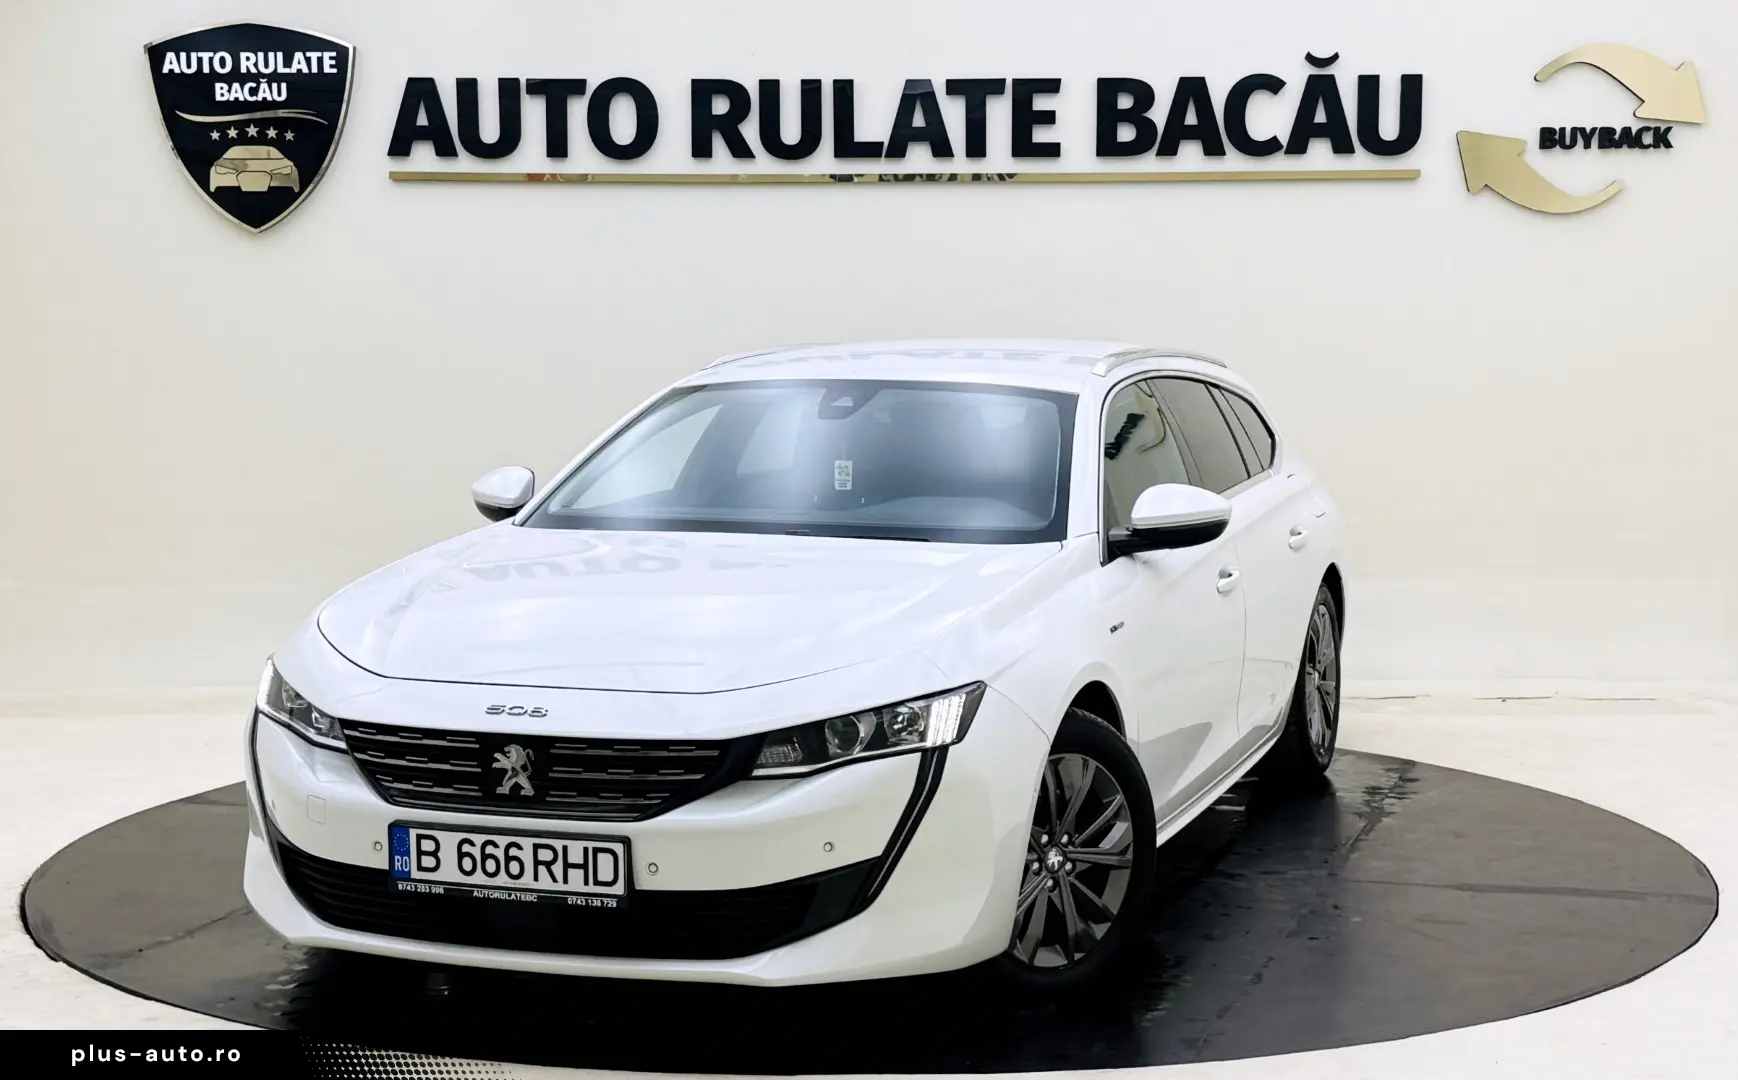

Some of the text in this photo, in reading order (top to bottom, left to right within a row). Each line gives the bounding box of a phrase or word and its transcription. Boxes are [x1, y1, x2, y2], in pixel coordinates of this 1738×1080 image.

[162, 51, 338, 74] AUTO RULATE
[214, 78, 288, 101] BACĂU
[387, 51, 1424, 160] AUTO RULATE BACĂU
[1539, 126, 1674, 150] BUYBACK
[485, 704, 549, 718] 508
[394, 855, 410, 872] RO
[415, 833, 619, 887] B 666 RHD
